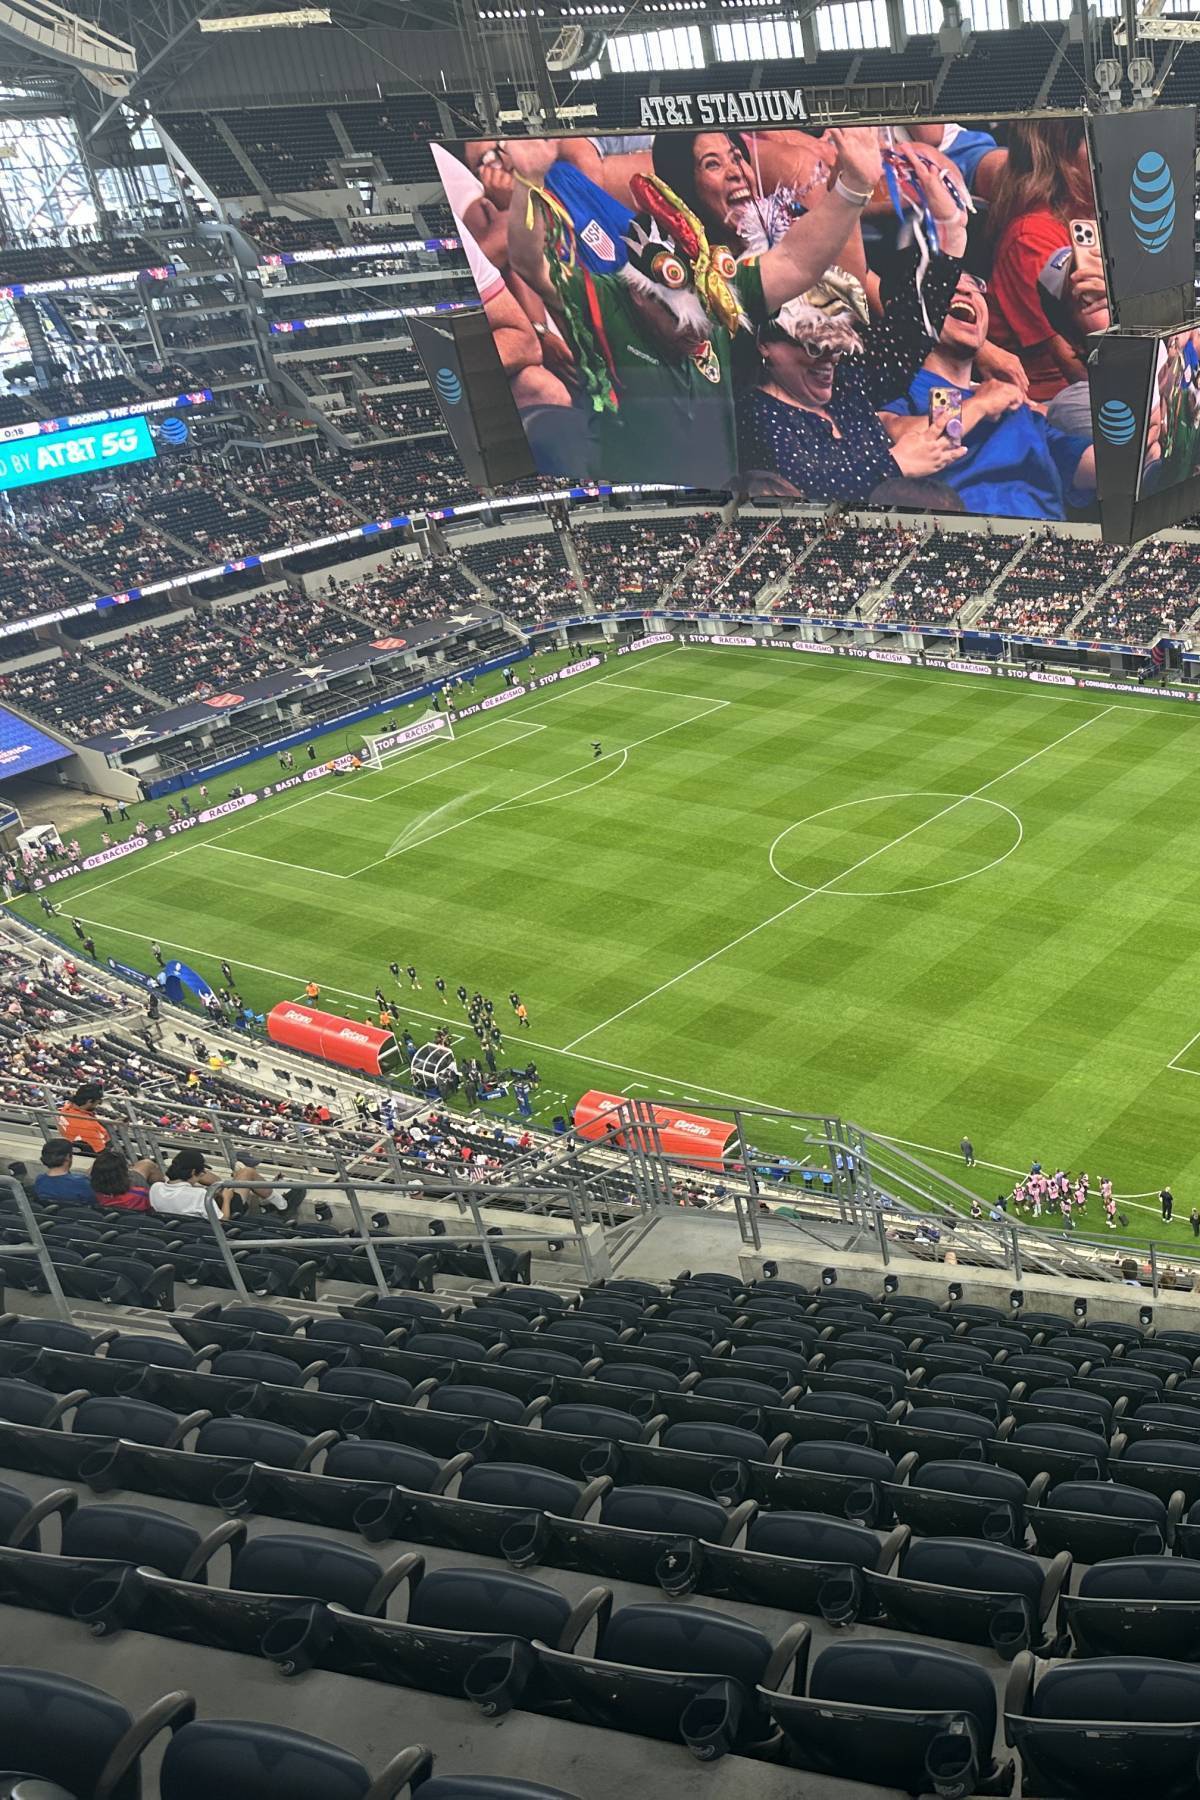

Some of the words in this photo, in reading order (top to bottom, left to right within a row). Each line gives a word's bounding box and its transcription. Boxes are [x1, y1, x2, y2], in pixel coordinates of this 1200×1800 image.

[640, 95, 693, 126] AT&T
[697, 89, 807, 124] STADIUM
[4, 428, 24, 438] 0:18
[11, 452, 31, 474] BY
[37, 436, 96, 469] AT&T
[102, 428, 138, 459] 5G
[719, 636, 747, 644] RACISM
[771, 640, 790, 648] BASTA
[805, 644, 831, 652] RACISMO
[618, 646, 630, 655] STA
[848, 649, 867, 657] STOP
[876, 652, 902, 661] RACISM
[540, 673, 558, 686] STOP
[567, 661, 591, 675] RACISM
[961, 663, 989, 673] RACISMO
[1008, 669, 1027, 678] STOP
[1038, 673, 1066, 683] RACISM
[1085, 680, 1116, 690] CONMEBOL
[1133, 686, 1158, 695] AMERICA
[1171, 690, 1185, 698] 2024
[459, 704, 481, 719] BASTA
[485, 699, 494, 707] DE
[495, 688, 522, 704] RACISMO
[406, 723, 435, 740] RACISM
[275, 776, 302, 792] BASTA
[307, 769, 318, 779] DE
[169, 817, 197, 834] STOP
[209, 798, 246, 818] RACISM
[48, 865, 80, 883] BASTA
[88, 856, 101, 867] DE
[103, 839, 144, 862] RACISMO
[285, 1010, 312, 1024] Betano
[340, 1028, 369, 1044] Betano
[674, 1119, 711, 1136] Betano
